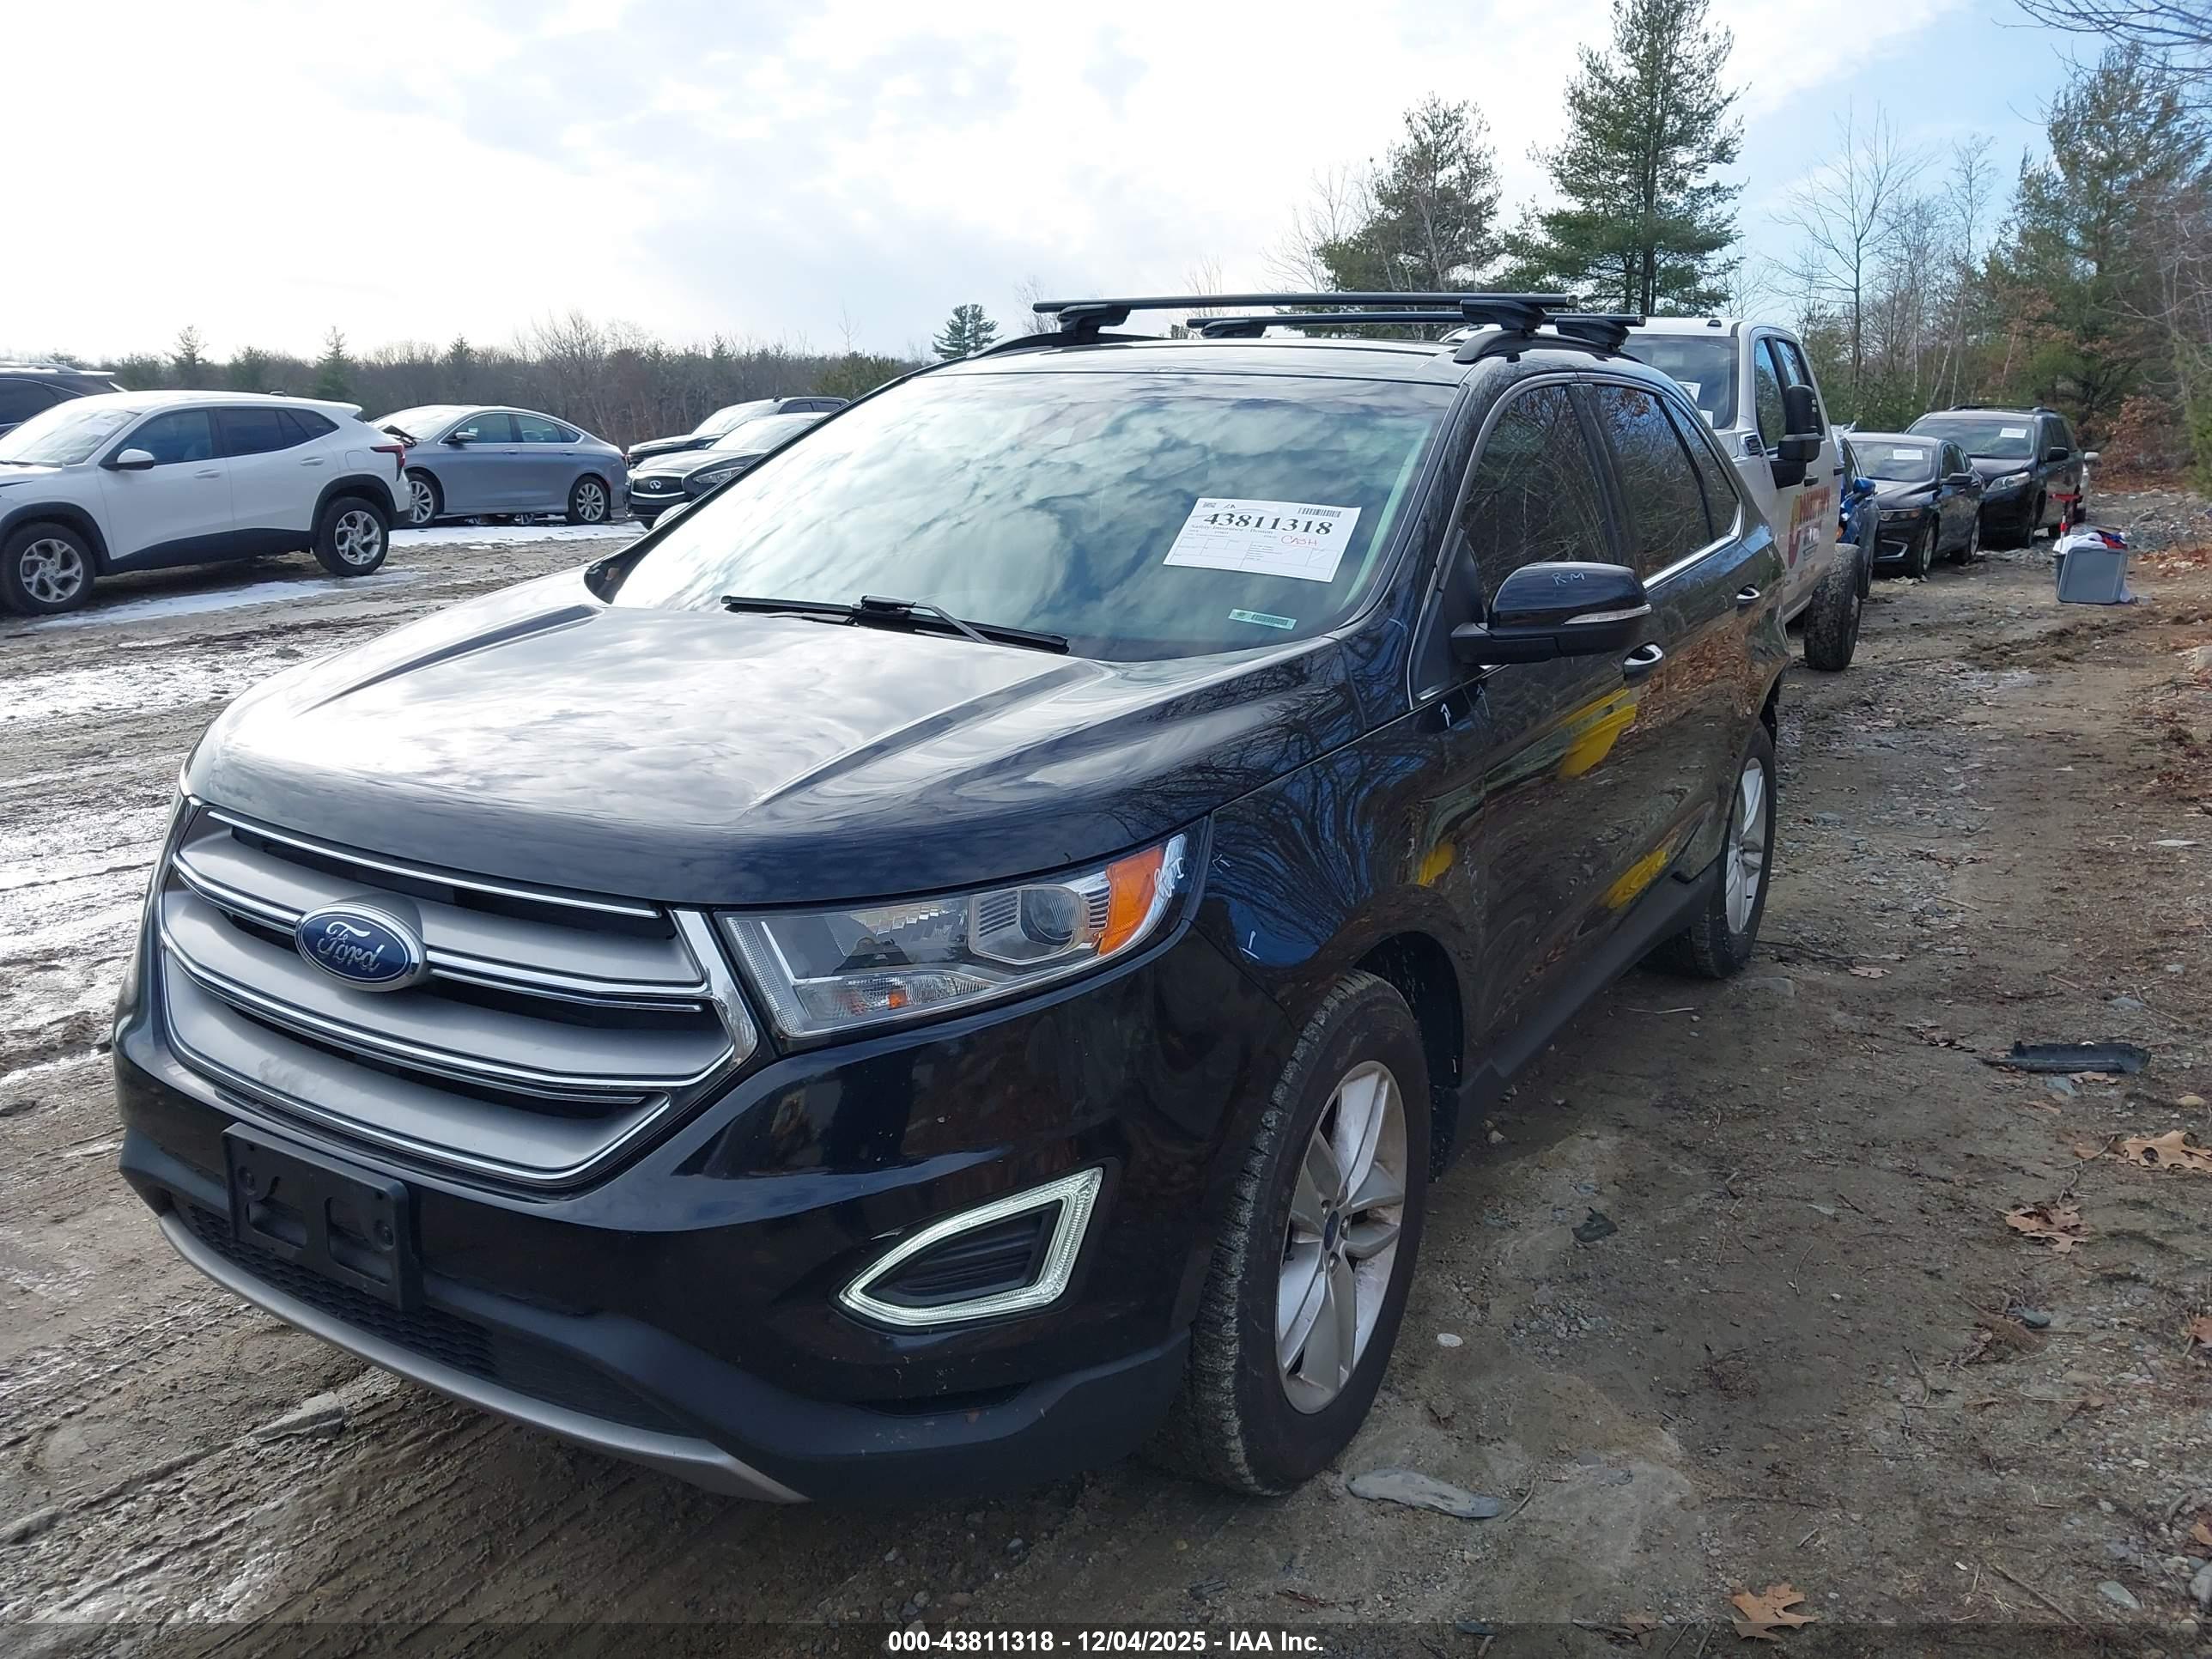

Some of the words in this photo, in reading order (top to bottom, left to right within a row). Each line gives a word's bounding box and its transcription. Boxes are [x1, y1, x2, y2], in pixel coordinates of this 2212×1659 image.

[1203, 513, 1333, 535] 43811318
[1281, 534, 1318, 547] CASH
[317, 921, 385, 972] Ford
